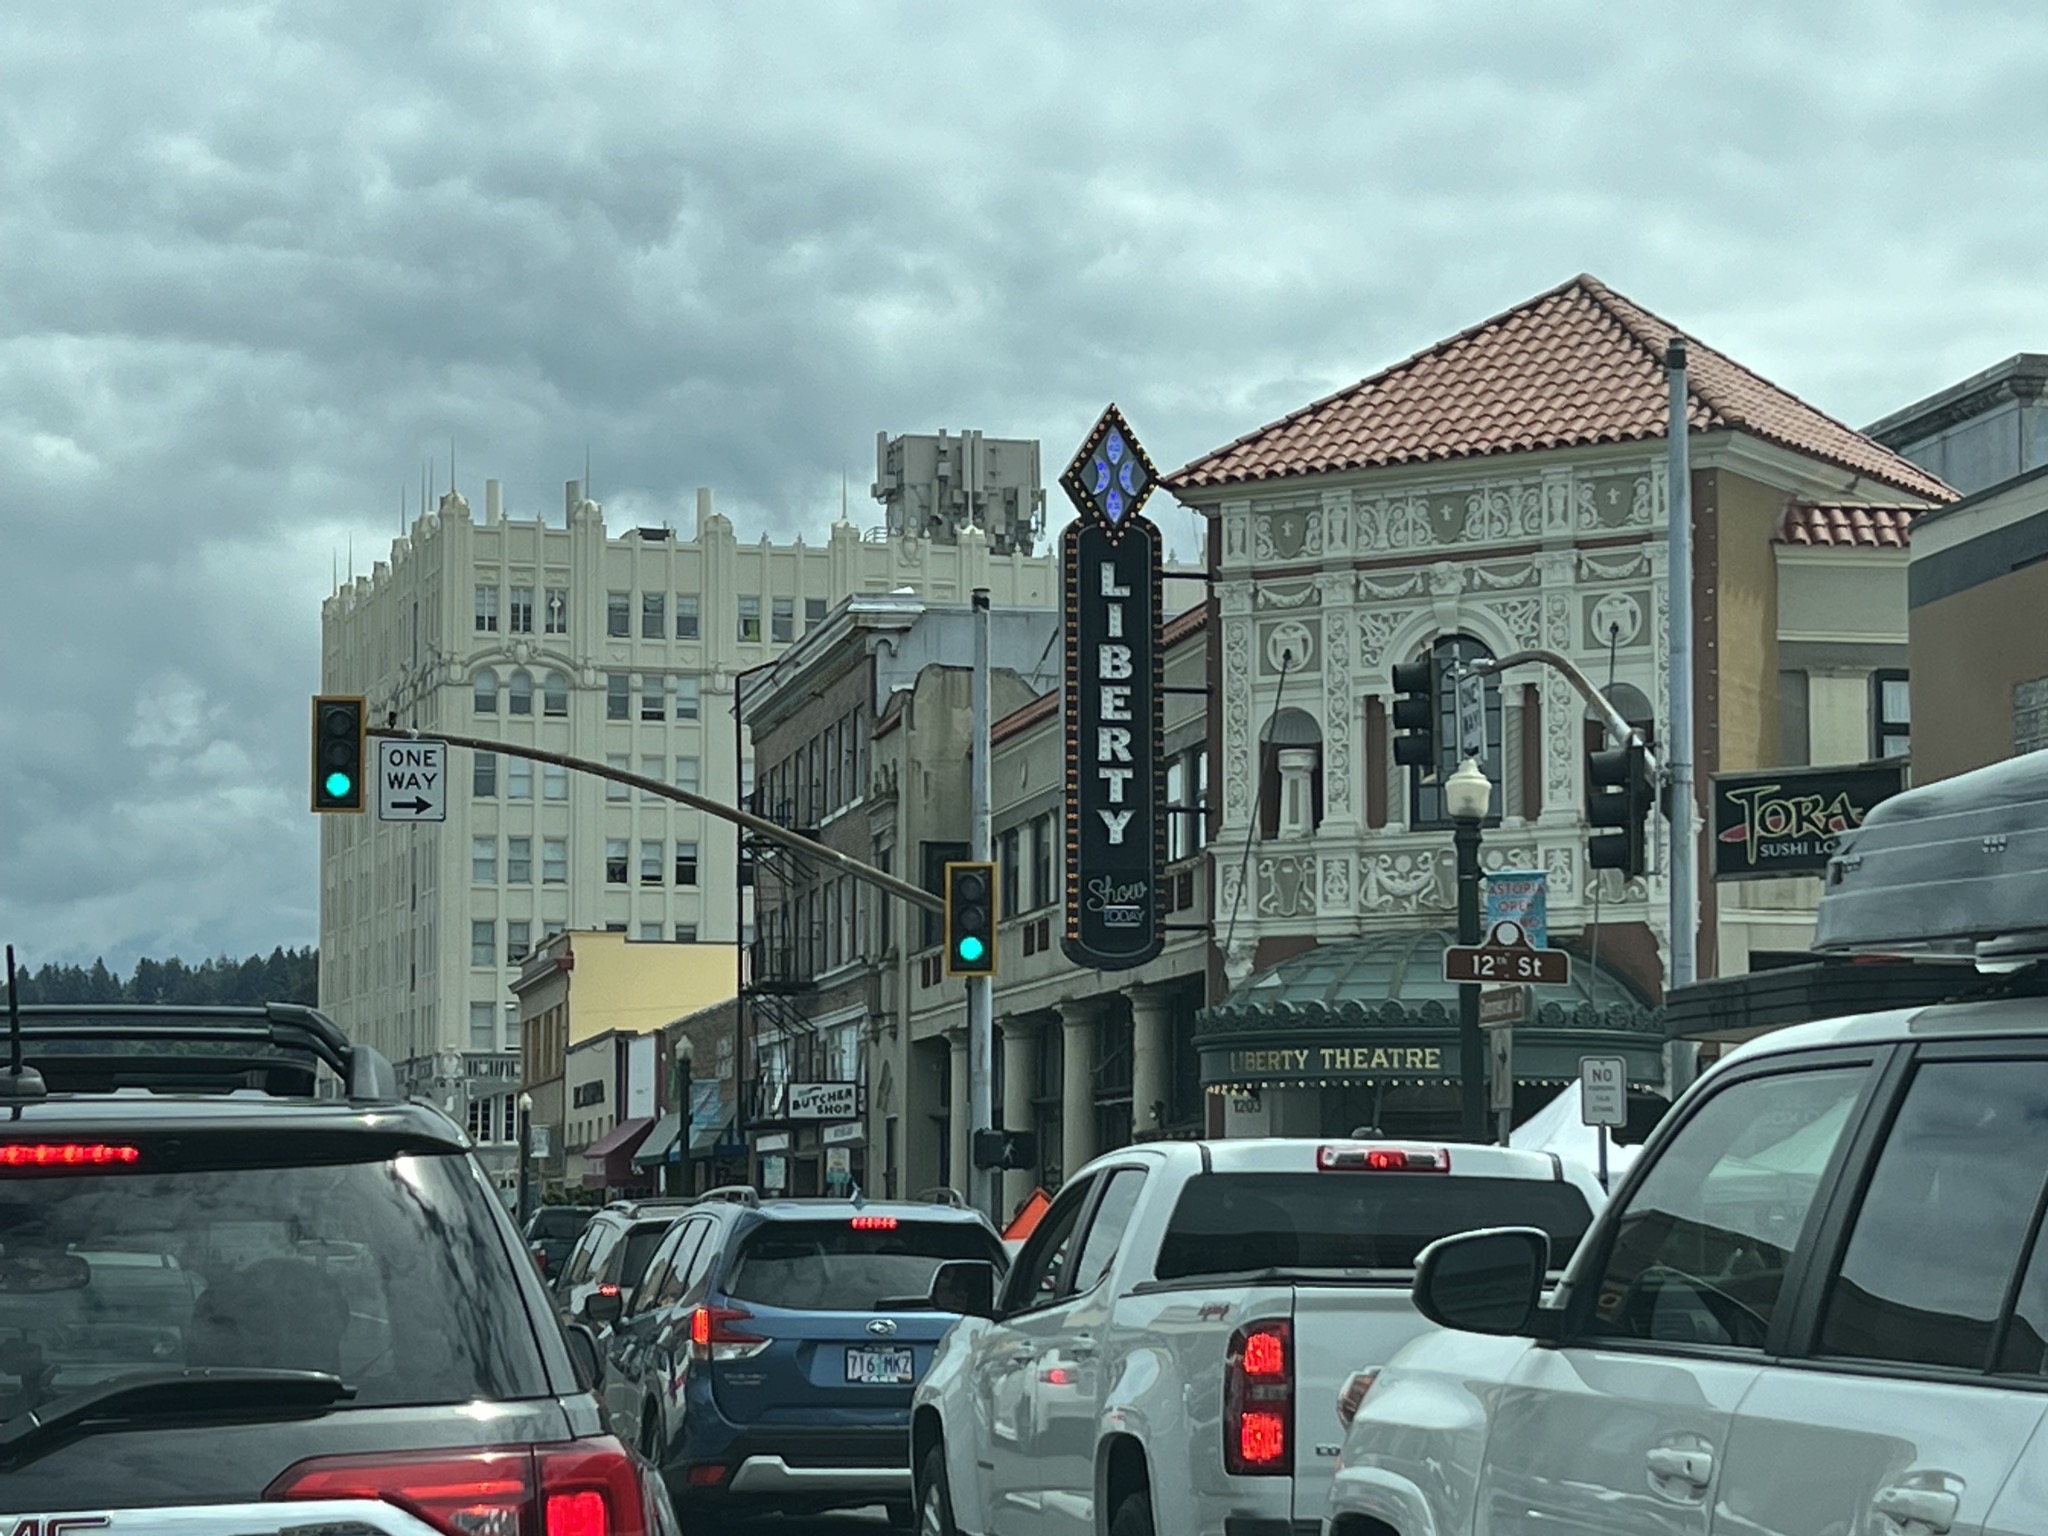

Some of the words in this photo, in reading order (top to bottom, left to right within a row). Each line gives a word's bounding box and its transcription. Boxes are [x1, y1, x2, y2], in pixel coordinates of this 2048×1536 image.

[1096, 560, 1134, 844] LIBERTY
[389, 749, 437, 767] ONE
[387, 772, 438, 790] WAY
[1759, 842, 1808, 858] SUSHI
[1086, 874, 1148, 912] Show
[1517, 957, 1542, 977] St
[1230, 1049, 1309, 1073] LIBERTY
[1320, 1048, 1442, 1070] THEATRE
[1592, 1068, 1613, 1082] NO
[792, 1088, 852, 1111] BUTCHER
[816, 1103, 852, 1115] SHOP
[1233, 1099, 1262, 1113] 1203
[849, 1355, 875, 1377] 716
